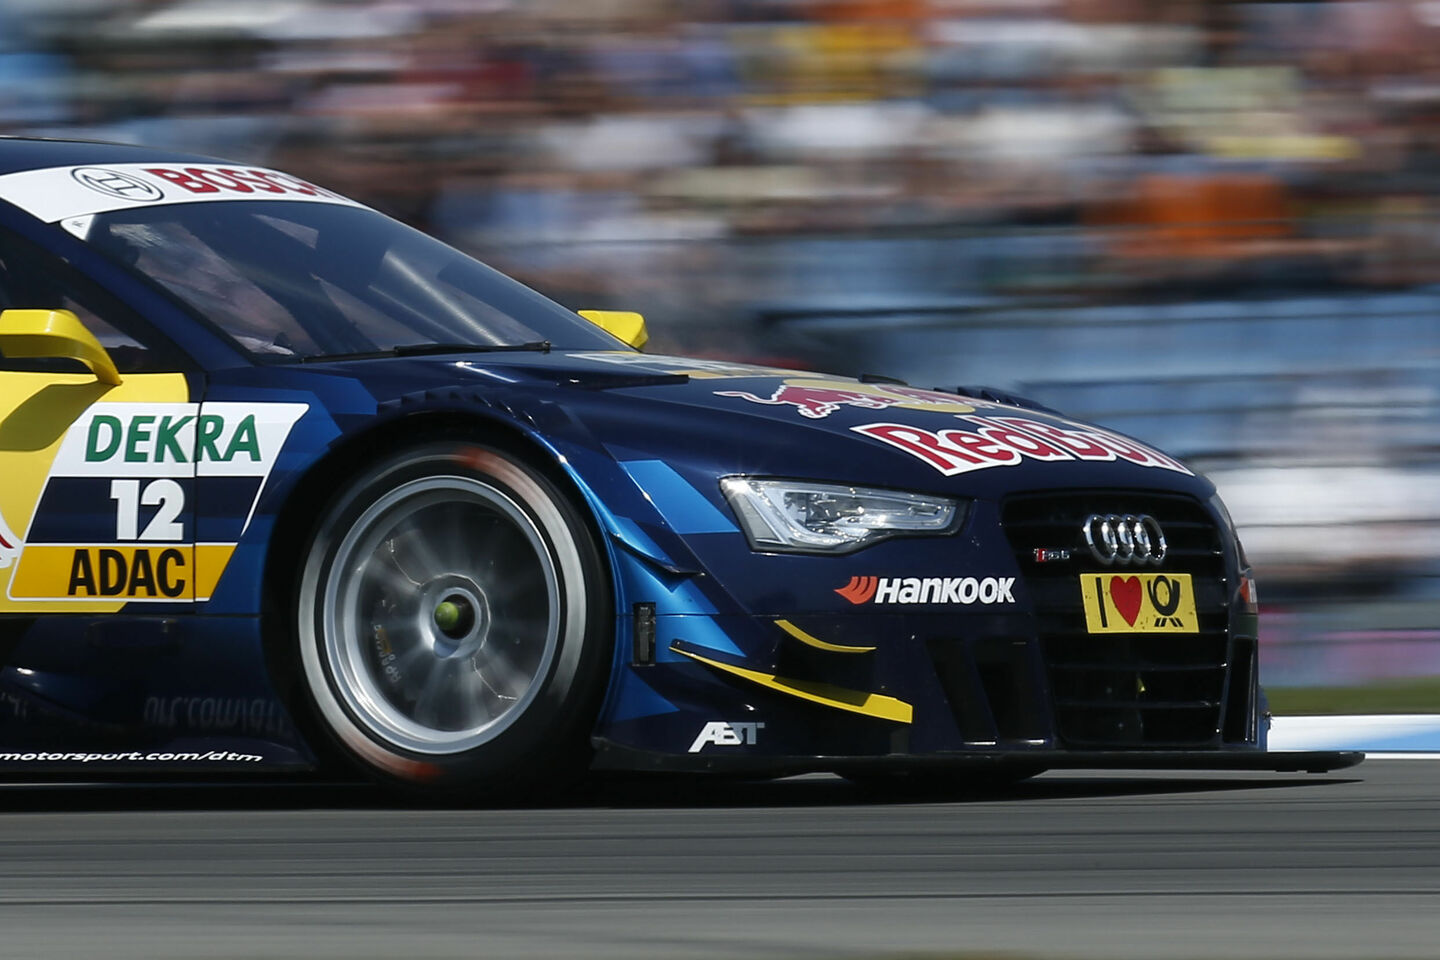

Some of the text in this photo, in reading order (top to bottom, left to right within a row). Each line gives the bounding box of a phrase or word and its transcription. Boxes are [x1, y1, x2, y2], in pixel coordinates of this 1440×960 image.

[84, 414, 262, 463] DEKRA
[110, 479, 185, 541] 12
[67, 548, 186, 597] ADAC
[687, 721, 766, 753] ABT
